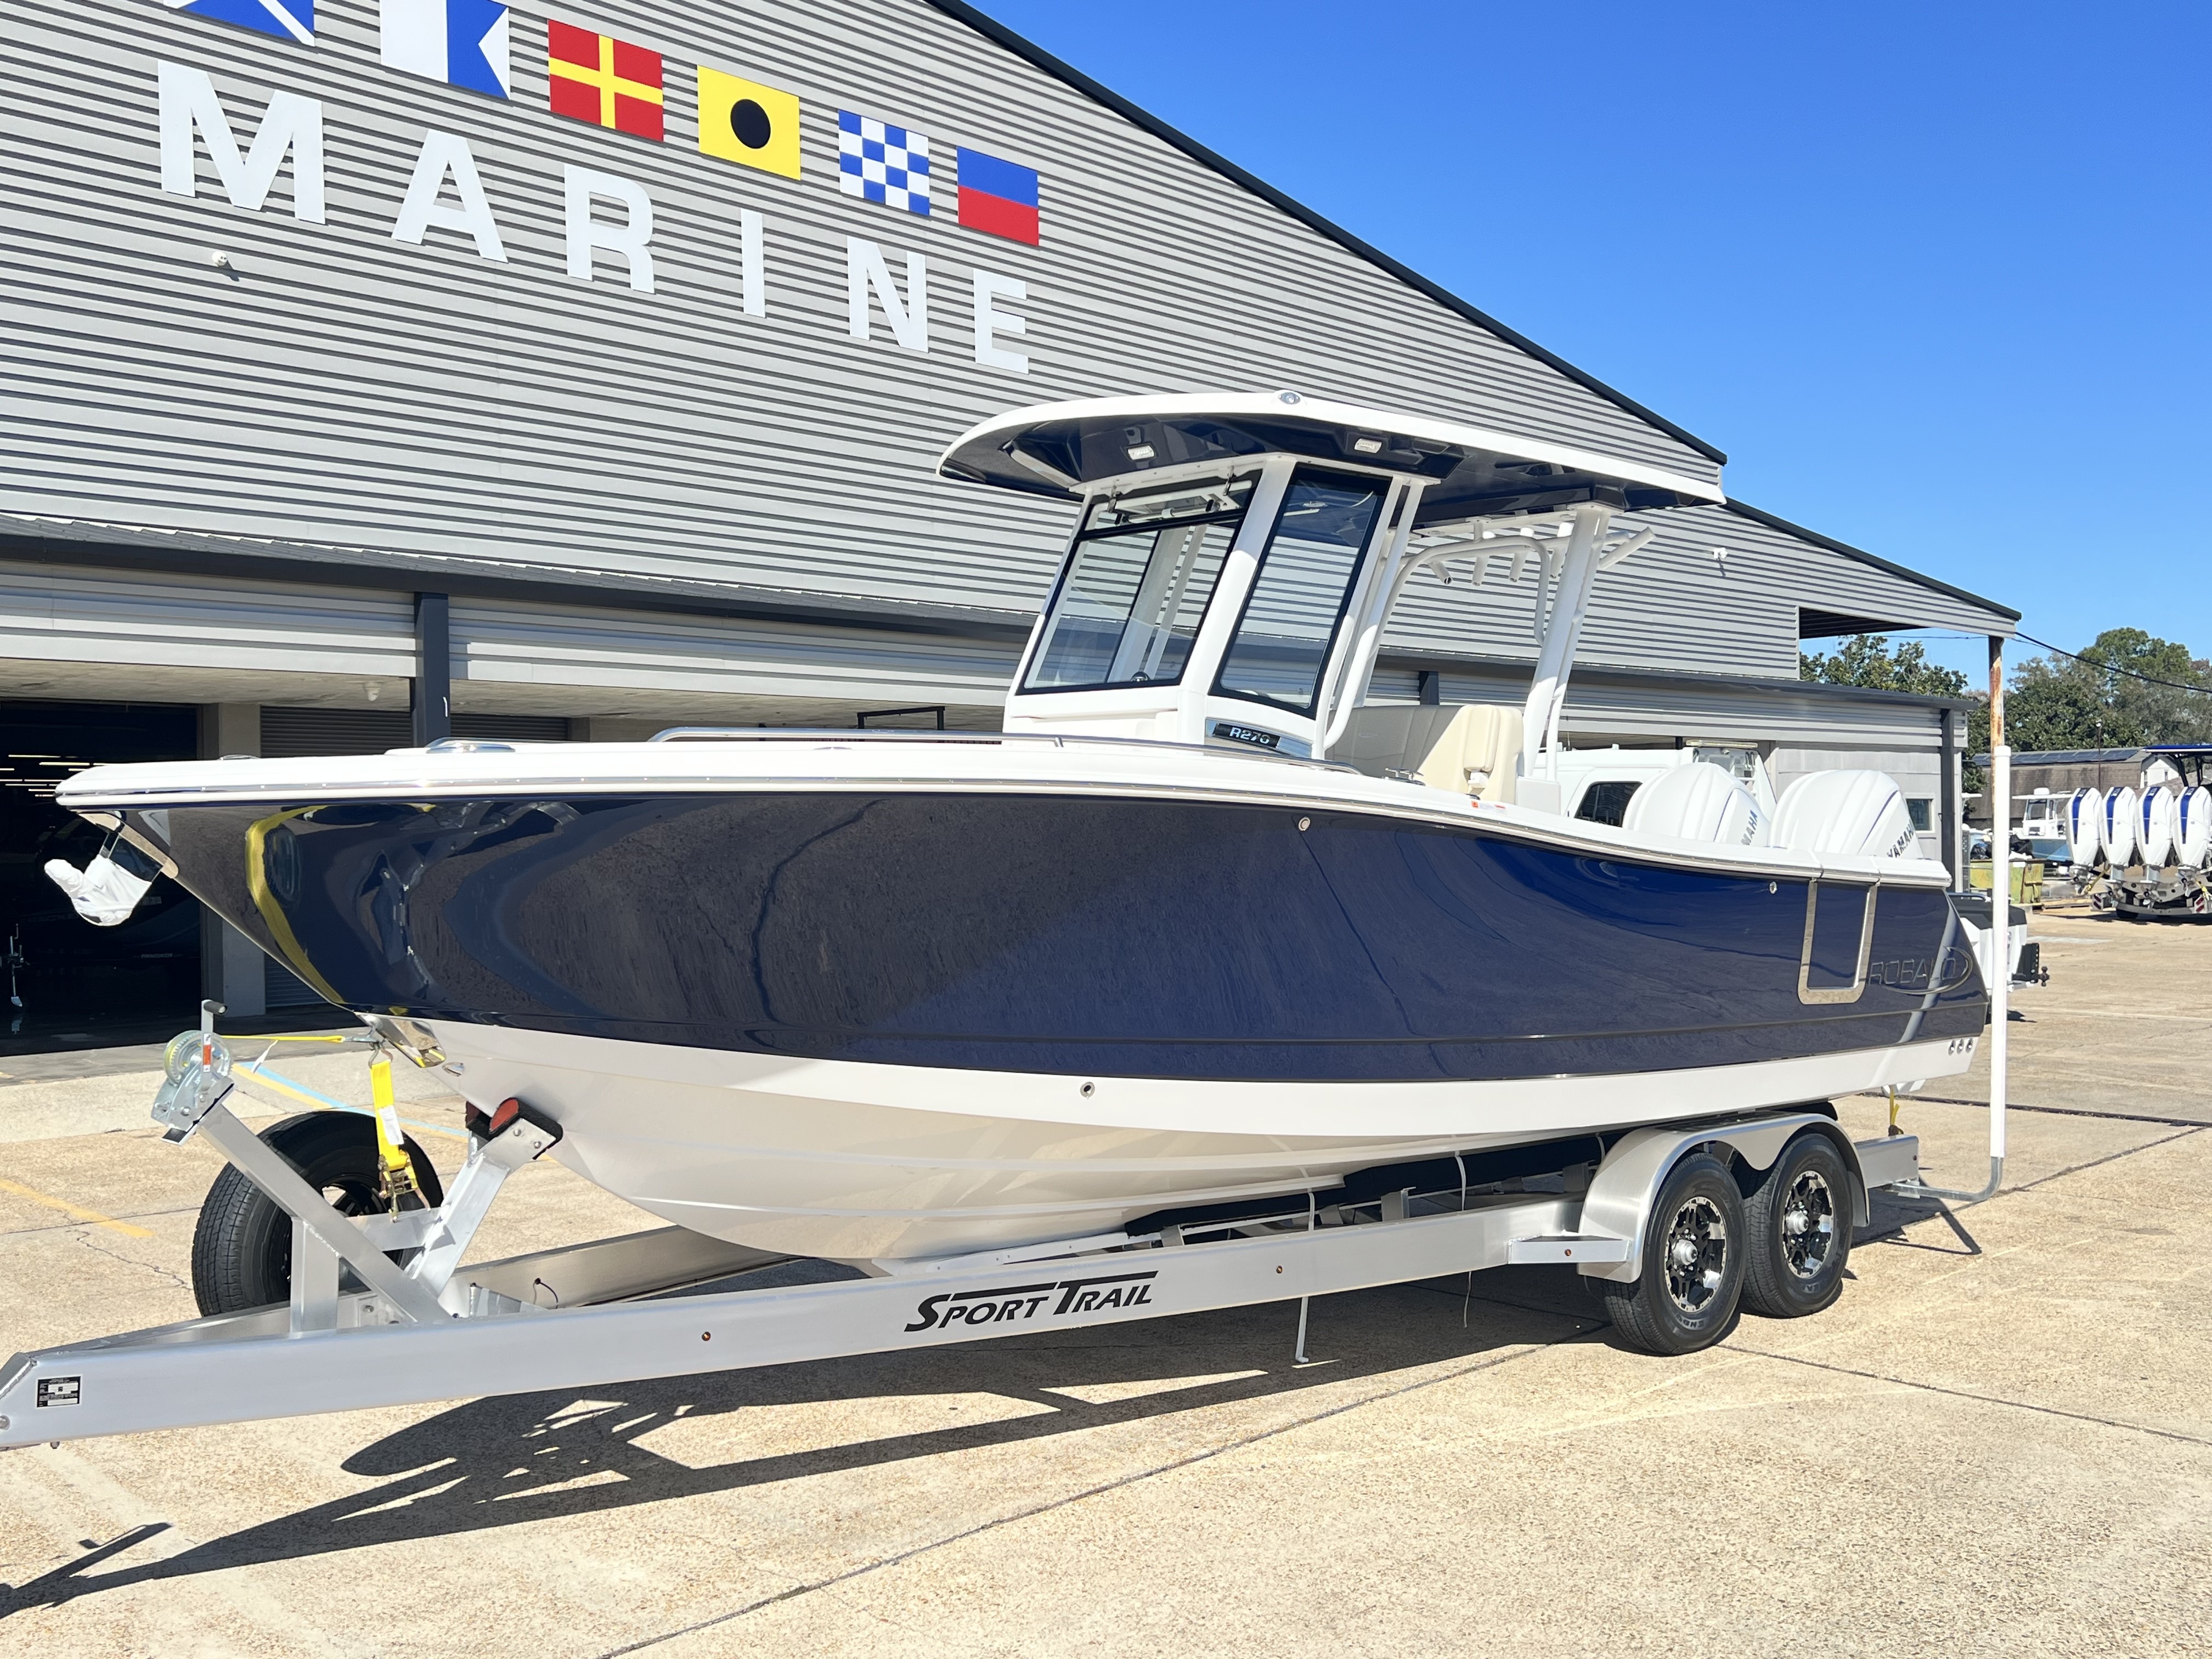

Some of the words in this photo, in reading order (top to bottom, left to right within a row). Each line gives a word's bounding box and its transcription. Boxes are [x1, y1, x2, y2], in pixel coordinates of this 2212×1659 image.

[158, 60, 1029, 374] MARINE
[1229, 727, 1270, 744] R270
[1741, 810, 1758, 845] MAHA
[1887, 823, 1914, 857] YAMAH
[904, 1282, 1058, 1332] SPORT
[1053, 1271, 1158, 1315] TRAIL
